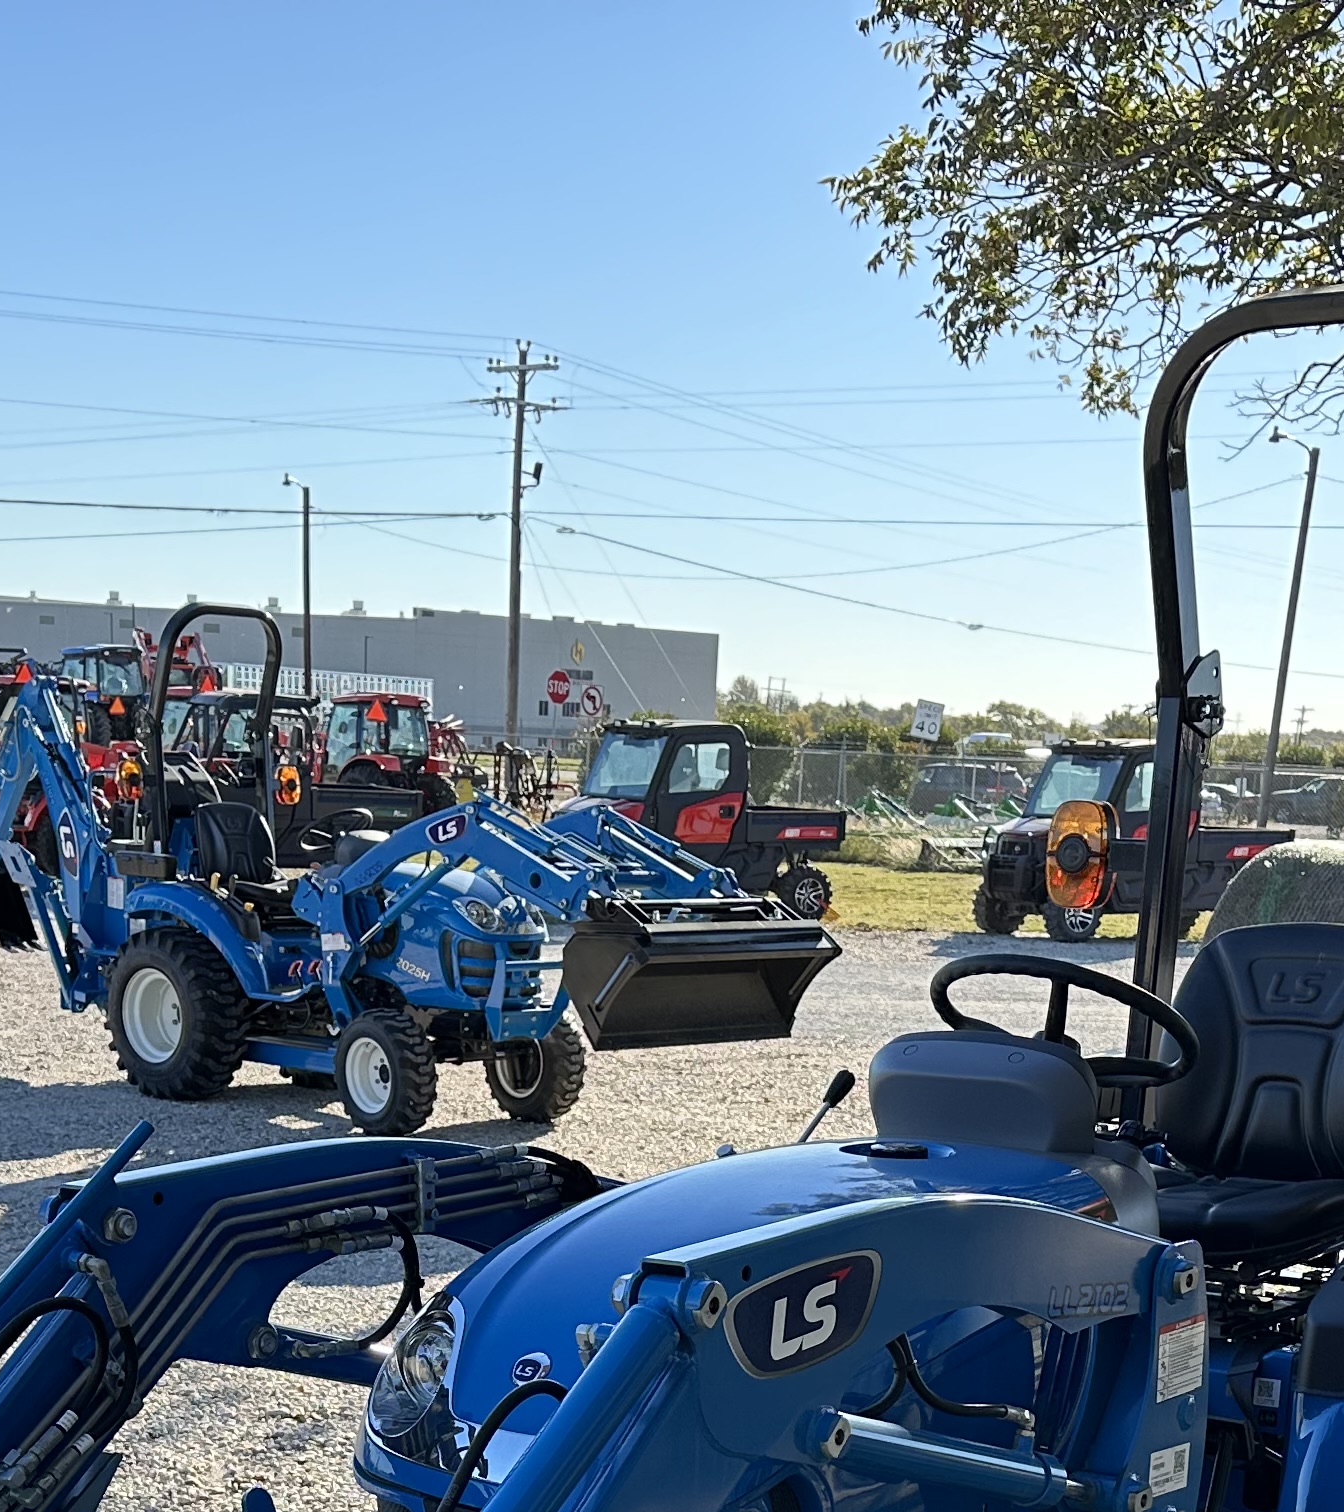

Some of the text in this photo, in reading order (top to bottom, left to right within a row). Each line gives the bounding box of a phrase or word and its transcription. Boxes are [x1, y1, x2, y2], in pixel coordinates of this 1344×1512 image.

[548, 680, 570, 695] STOP
[915, 720, 938, 735] 40
[59, 825, 76, 859] LS
[437, 820, 458, 842] LS
[1265, 971, 1326, 1004] LS
[1047, 1282, 1129, 1319] LL2102
[770, 1279, 837, 1361] LS
[515, 1364, 535, 1377] LS
